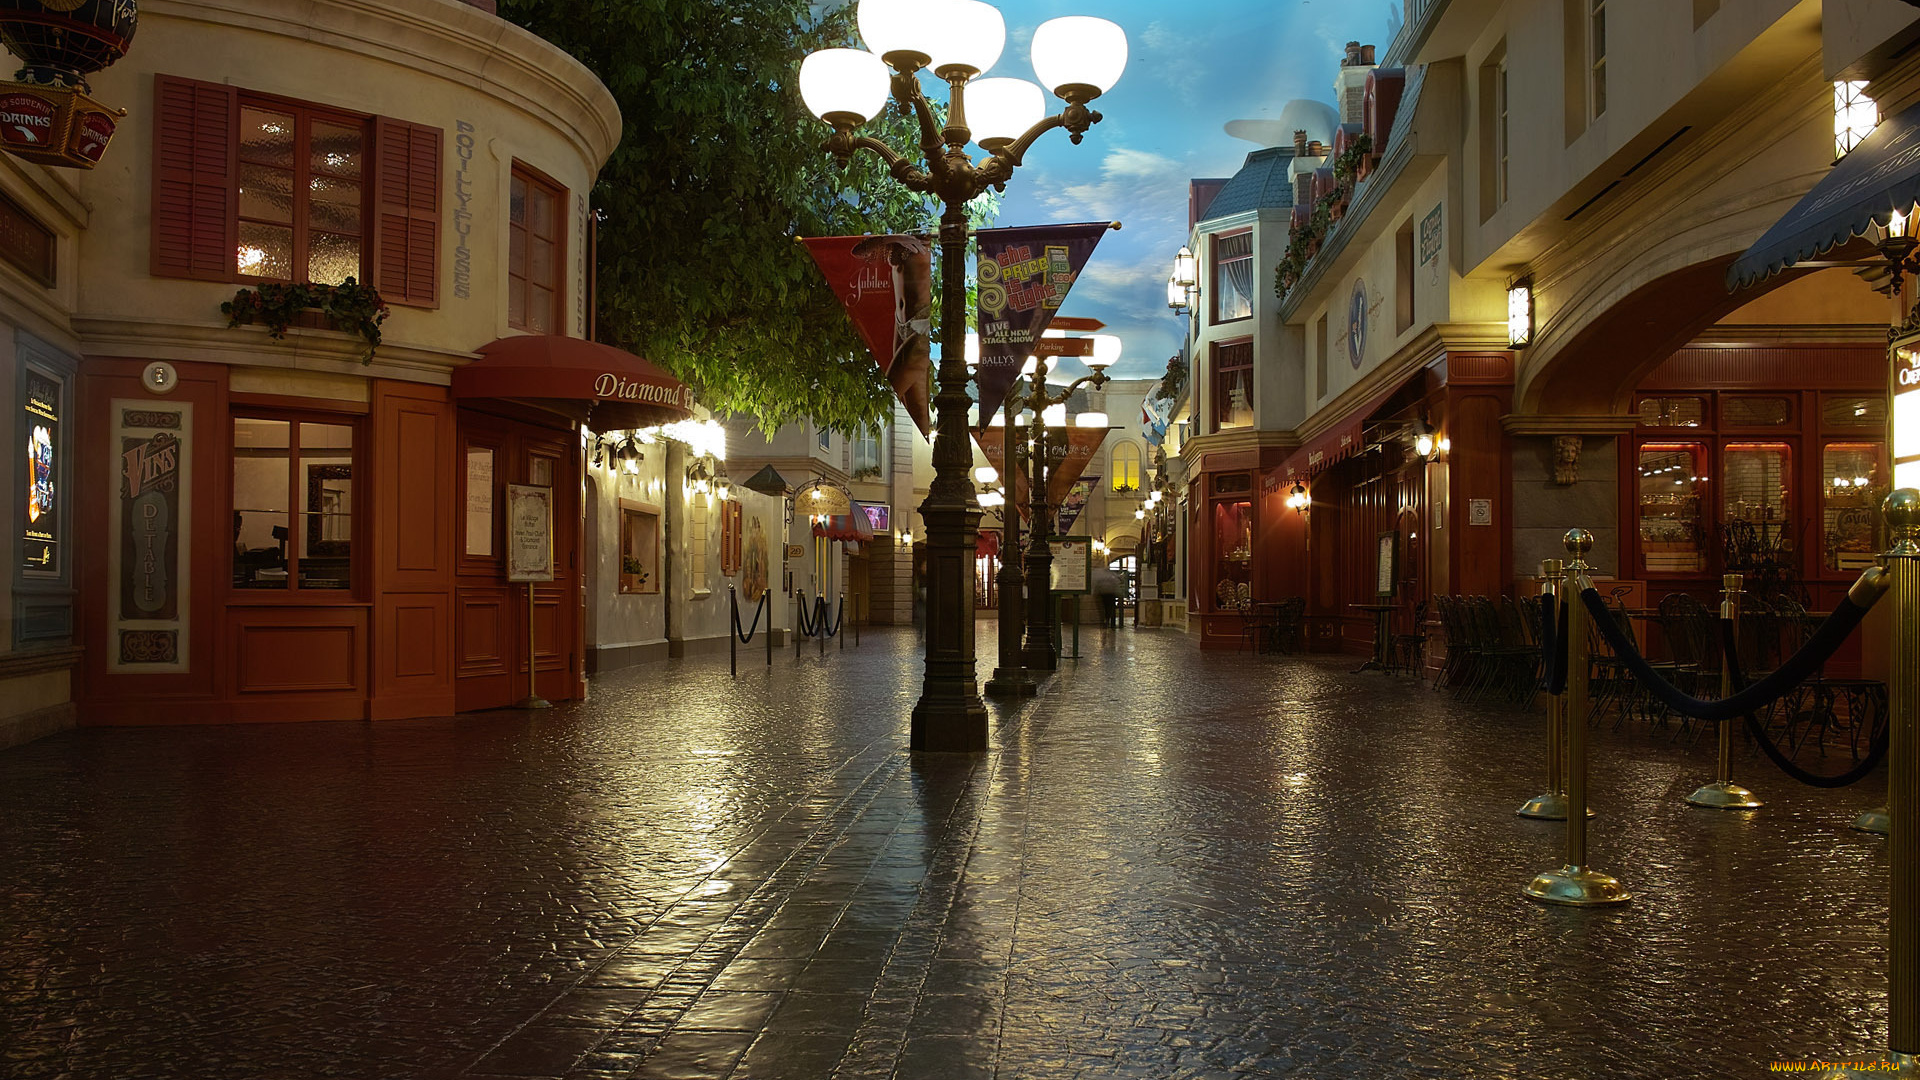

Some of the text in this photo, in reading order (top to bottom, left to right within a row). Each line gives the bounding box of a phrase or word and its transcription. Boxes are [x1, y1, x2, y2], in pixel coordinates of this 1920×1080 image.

[9, 97, 51, 115] SOUVENIR
[0, 111, 51, 128] DRINKS
[81, 125, 109, 146] DRINKS
[997, 245, 1031, 267] the
[985, 321, 1010, 336] LIVE
[1039, 343, 1064, 352] Parking
[982, 355, 1015, 365] BALLY'S
[594, 373, 683, 406] Diamond
[122, 442, 177, 499] VINS
